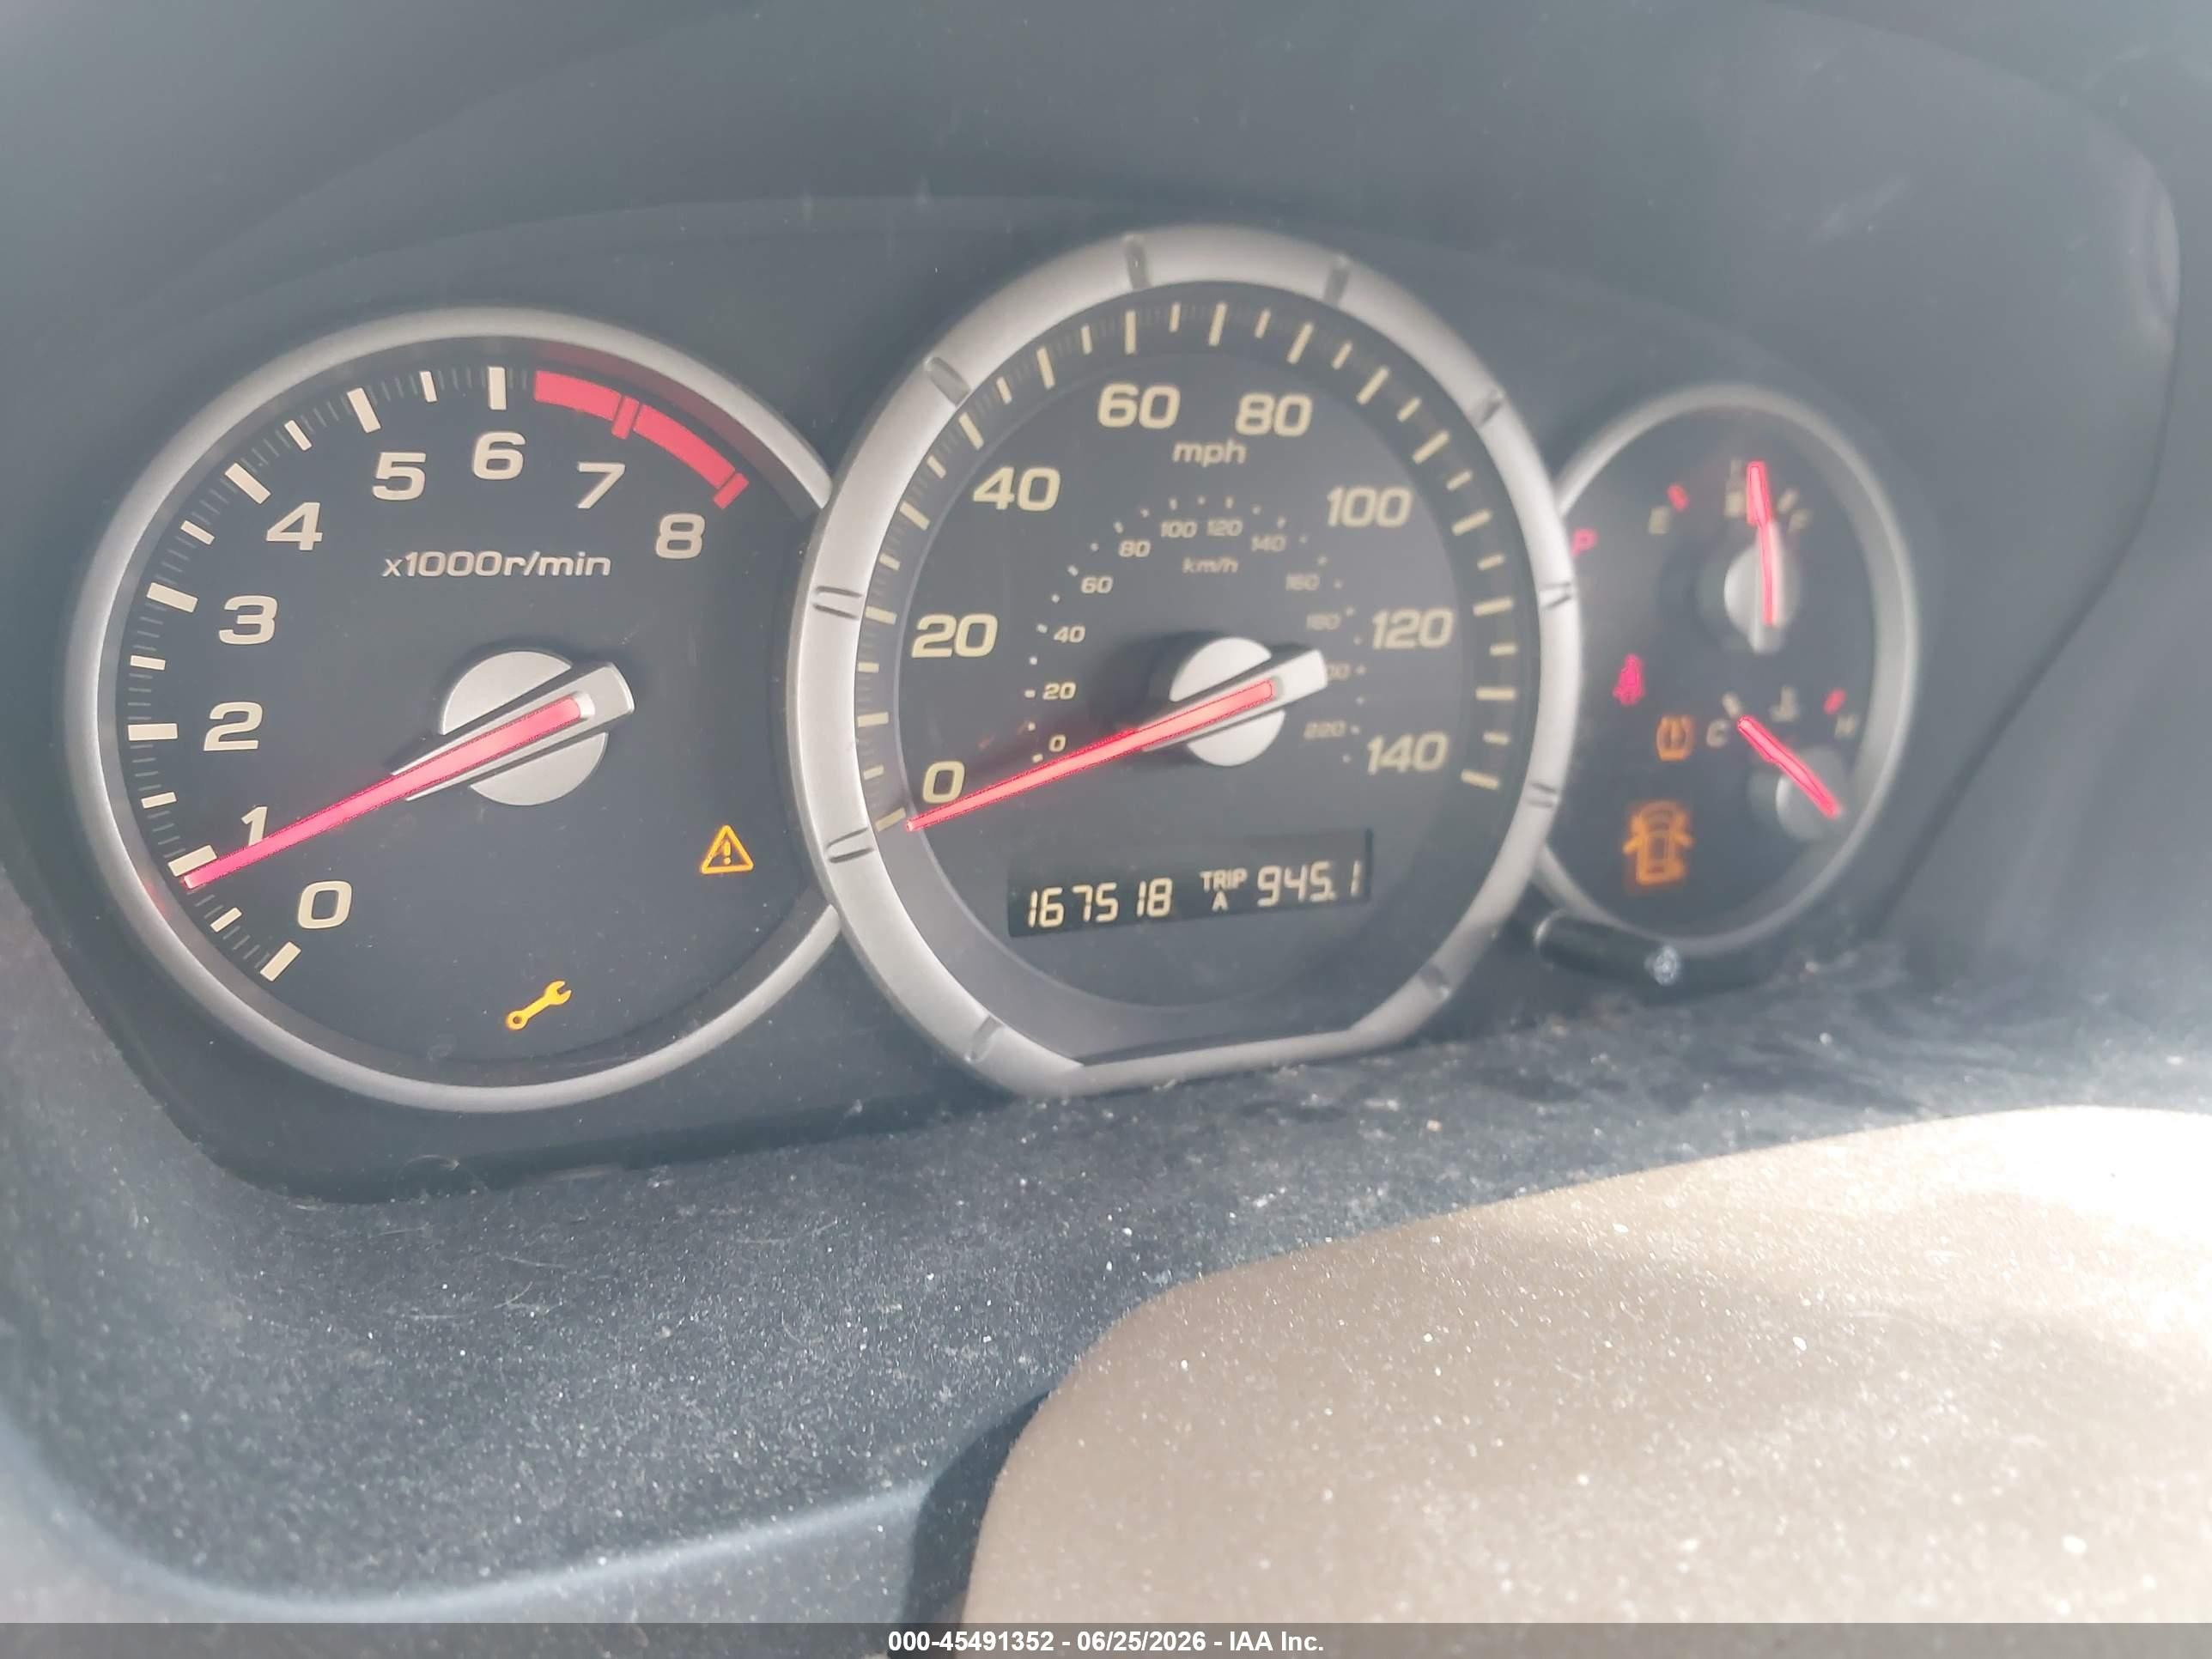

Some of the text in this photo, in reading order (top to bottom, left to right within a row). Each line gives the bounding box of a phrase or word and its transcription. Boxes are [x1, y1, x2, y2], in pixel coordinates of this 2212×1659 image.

[1097, 384, 1180, 428] 60
[1235, 393, 1312, 436] 80
[472, 433, 526, 479] 6
[1172, 439, 1247, 467] mph
[372, 452, 427, 501] 5
[577, 463, 625, 509] 7
[973, 467, 1061, 511] 40
[266, 502, 323, 551] 4
[1206, 519, 1243, 537] 120
[1327, 487, 1413, 528] 100
[656, 514, 705, 560] 8
[1119, 540, 1152, 557] 80
[1161, 520, 1197, 538] 100
[1251, 534, 1286, 551] 140
[1571, 528, 1598, 556] P
[382, 550, 611, 579] x1000r/min
[1081, 576, 1114, 593] 60
[1182, 557, 1238, 574] km/h
[218, 595, 278, 645] 3
[910, 613, 998, 658] 20
[1054, 626, 1086, 643] 40
[1372, 609, 1454, 649] 120
[1042, 683, 1077, 700] 20
[204, 702, 263, 751] 2
[1048, 735, 1066, 752] 0
[1367, 732, 1448, 775] 140
[922, 761, 966, 804] 0
[241, 806, 268, 847] 1
[1200, 868, 1248, 891] TRIP
[1257, 860, 1362, 908] 945.1
[298, 880, 352, 929] 0
[1028, 877, 1173, 928] 167518
[1212, 891, 1228, 913] A
